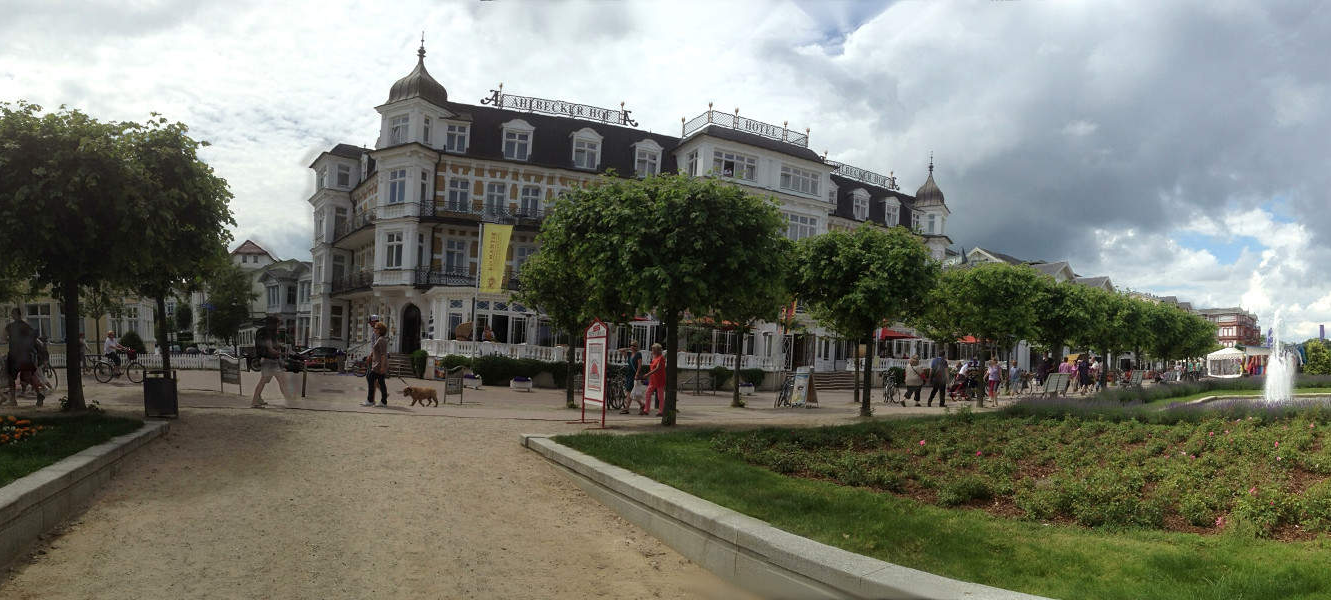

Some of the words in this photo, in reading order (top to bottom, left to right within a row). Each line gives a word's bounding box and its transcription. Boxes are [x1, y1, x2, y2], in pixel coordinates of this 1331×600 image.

[510, 97, 584, 116] AHLBECKER
[589, 109, 611, 121] HOF
[744, 120, 777, 137] HOTEL
